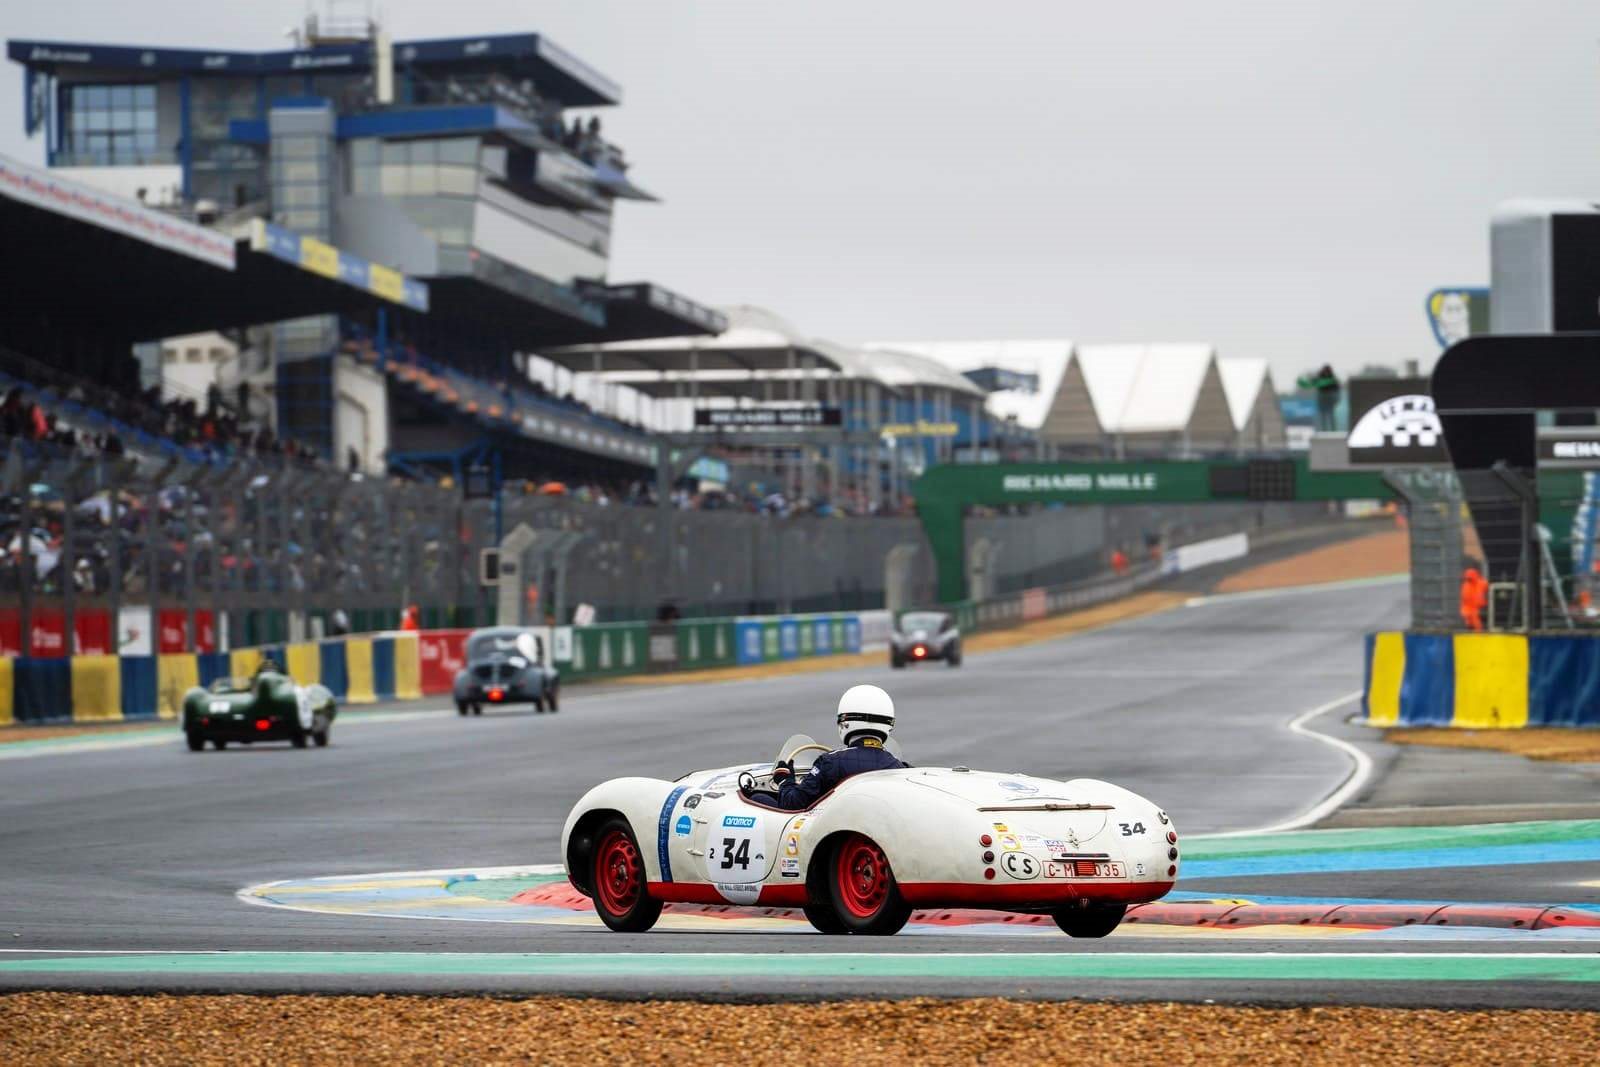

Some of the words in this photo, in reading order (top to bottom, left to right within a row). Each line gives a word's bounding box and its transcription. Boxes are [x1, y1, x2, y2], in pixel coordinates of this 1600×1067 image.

[1003, 474, 1092, 491] RICHARD
[1096, 473, 1157, 490] MILLE
[725, 817, 753, 826] aramco
[1118, 822, 1147, 837] 34
[709, 847, 715, 859] 2
[720, 837, 751, 870] 34
